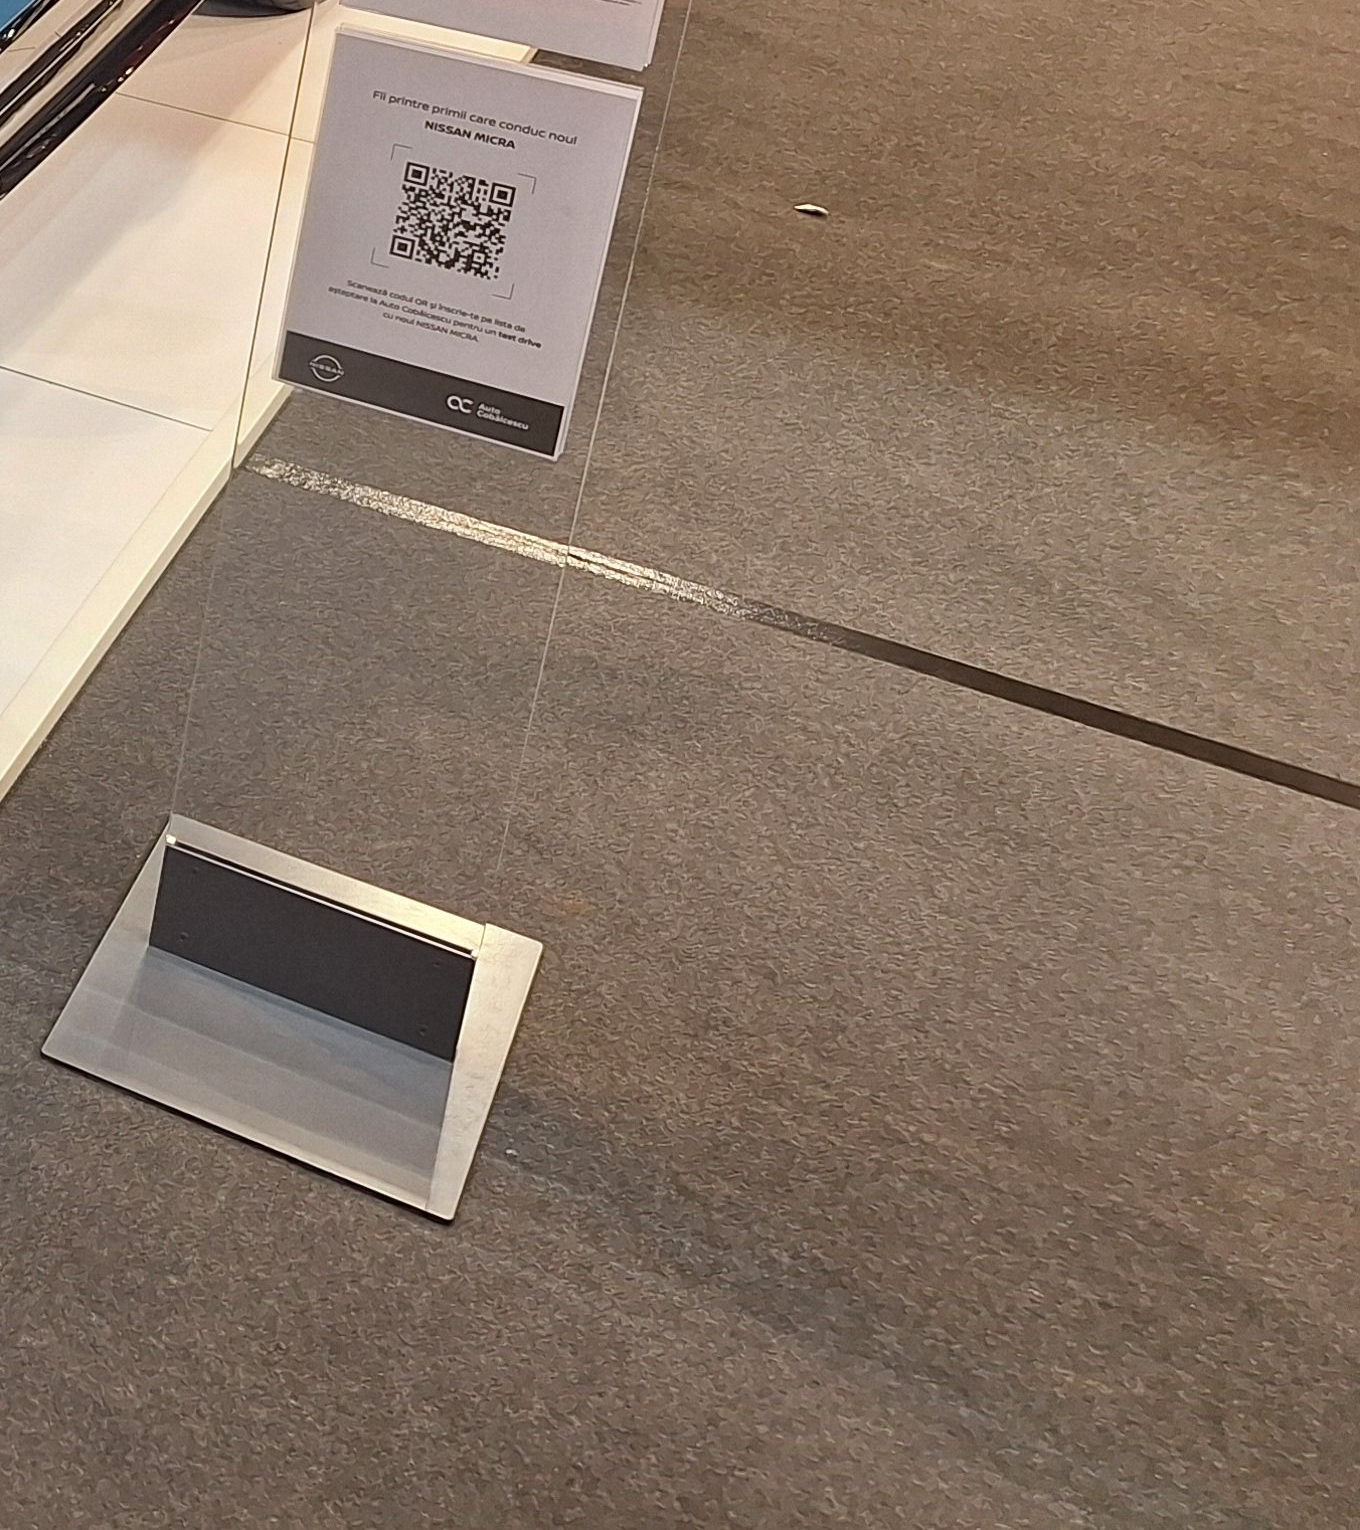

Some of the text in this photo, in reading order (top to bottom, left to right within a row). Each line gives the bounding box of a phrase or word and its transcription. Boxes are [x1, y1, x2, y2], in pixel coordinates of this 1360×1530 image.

[373, 90, 578, 145] Fii printre primii care conduc noul
[425, 120, 516, 149] NISSAN MICRA
[478, 403, 501, 415] Auto
